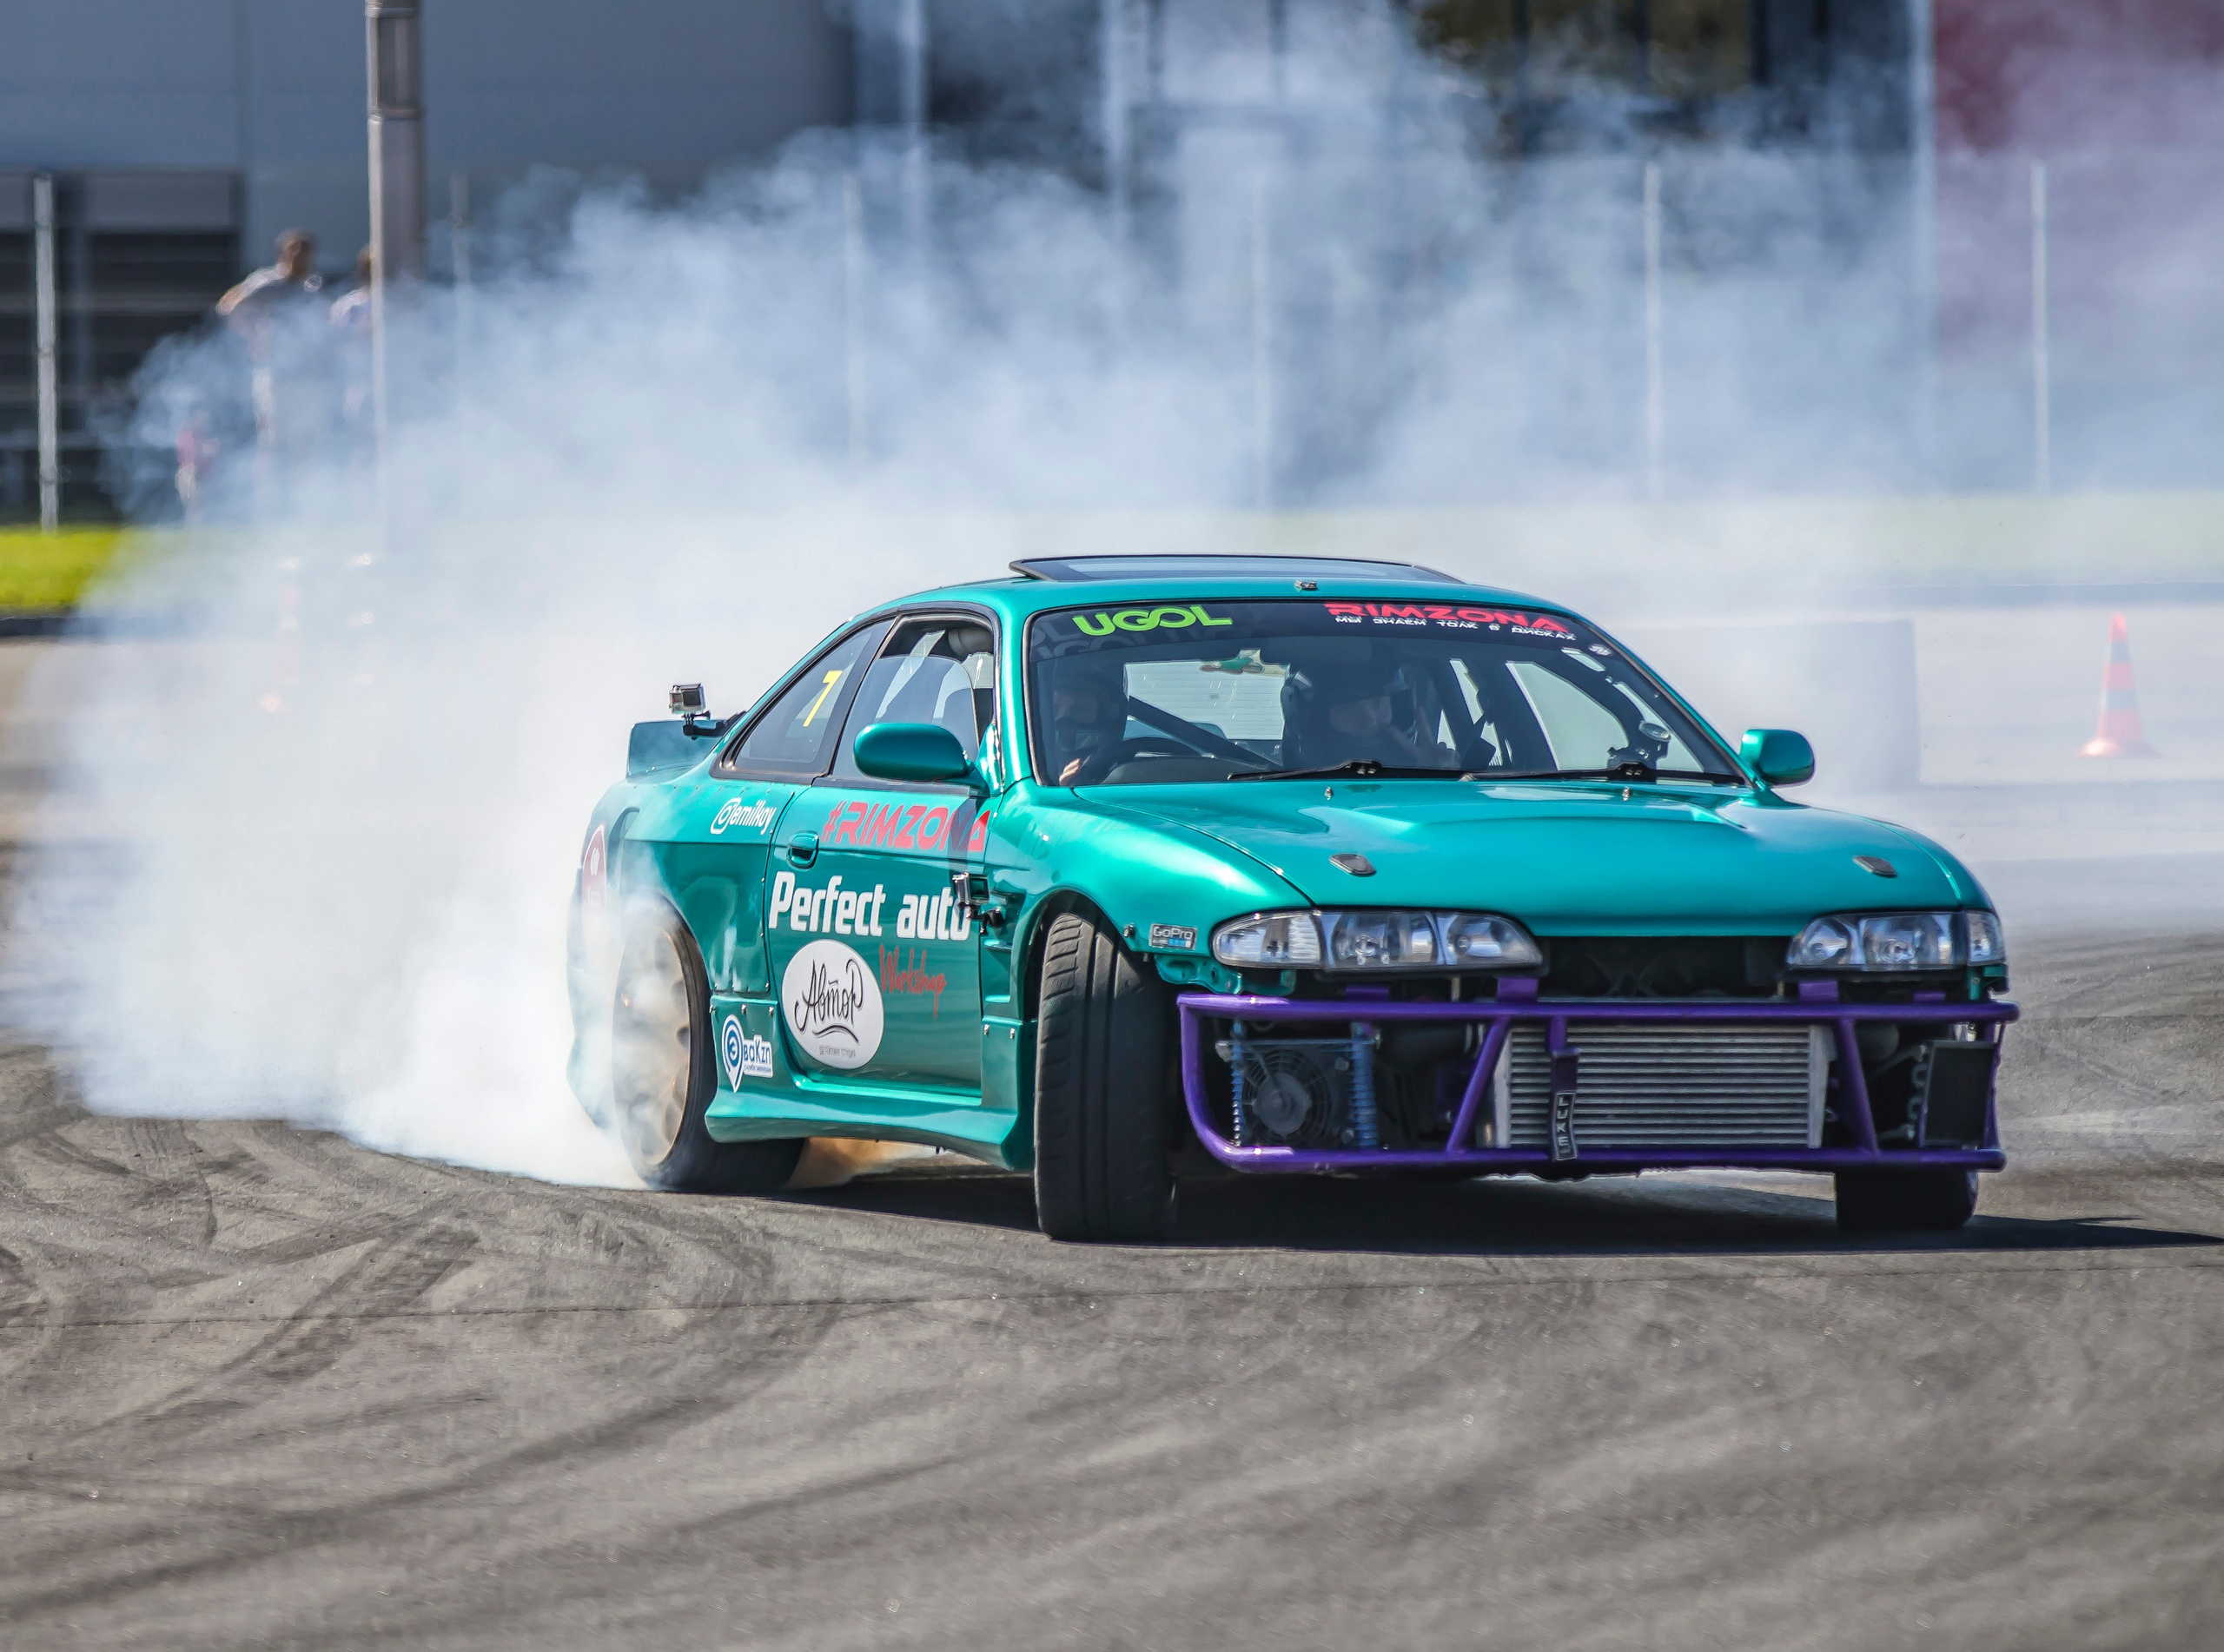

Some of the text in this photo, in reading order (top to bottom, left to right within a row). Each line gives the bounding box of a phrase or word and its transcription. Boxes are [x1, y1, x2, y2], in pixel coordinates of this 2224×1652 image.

[1072, 605, 1233, 636] UGOL
[1324, 602, 1569, 633] RIMZONA
[821, 800, 991, 853] #RIMZONA
[768, 870, 971, 941] Perfect auto
[1153, 926, 1193, 940] GoPro
